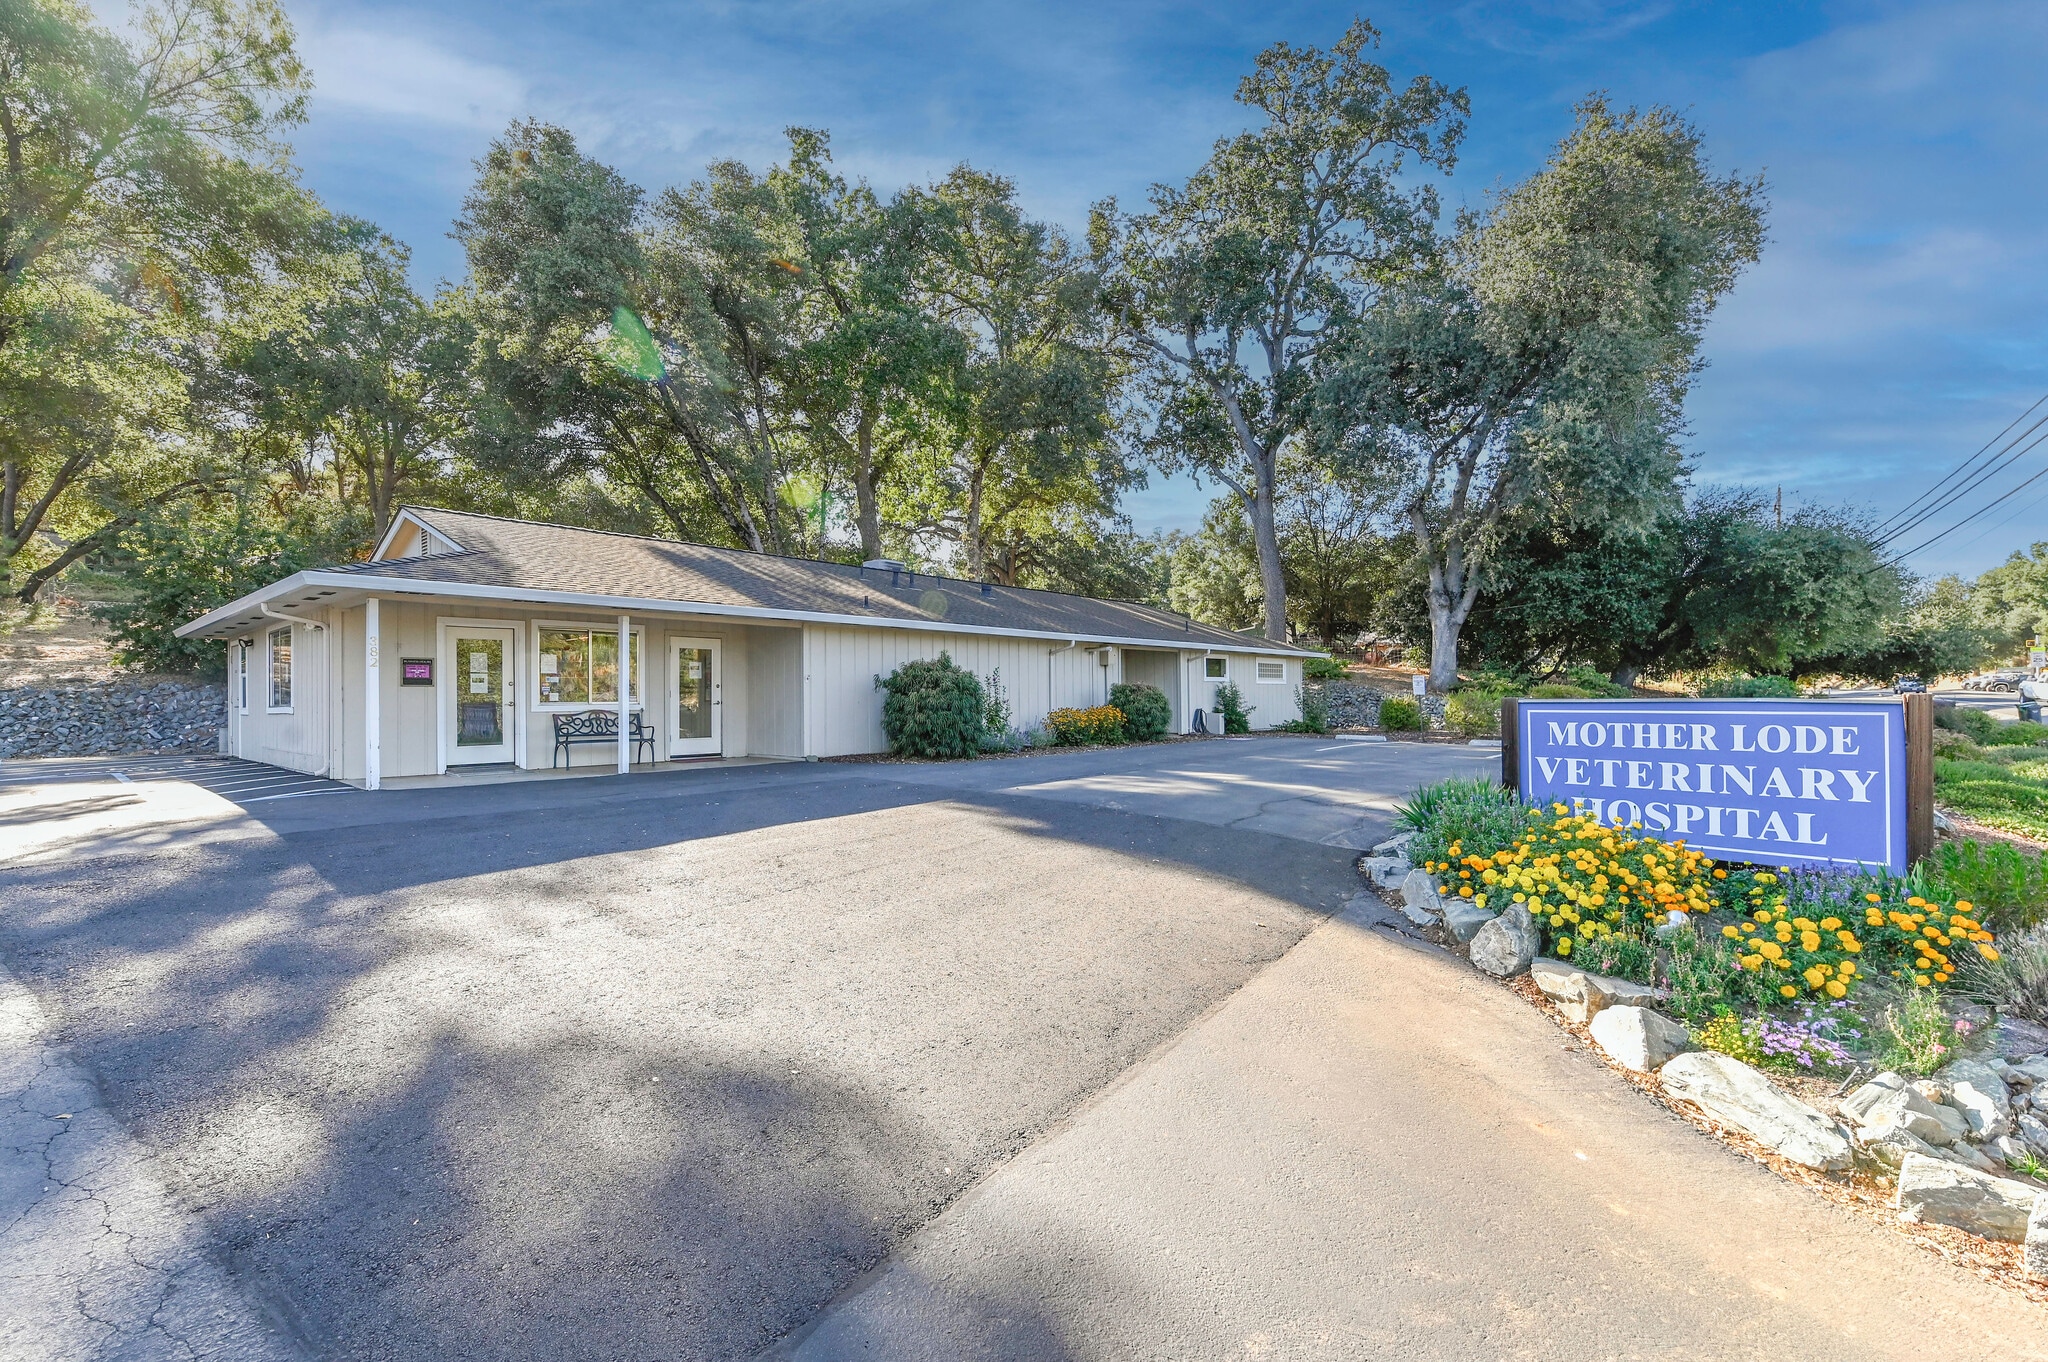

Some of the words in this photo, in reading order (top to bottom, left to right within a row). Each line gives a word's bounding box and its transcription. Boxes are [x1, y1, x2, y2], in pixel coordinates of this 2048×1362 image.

[370, 636, 378, 668] 382
[1546, 721, 1719, 751] MOTHER
[1730, 724, 1860, 755] LODE
[1535, 756, 1879, 803] VETERINARY
[1571, 796, 1828, 845] HOSPITAL
